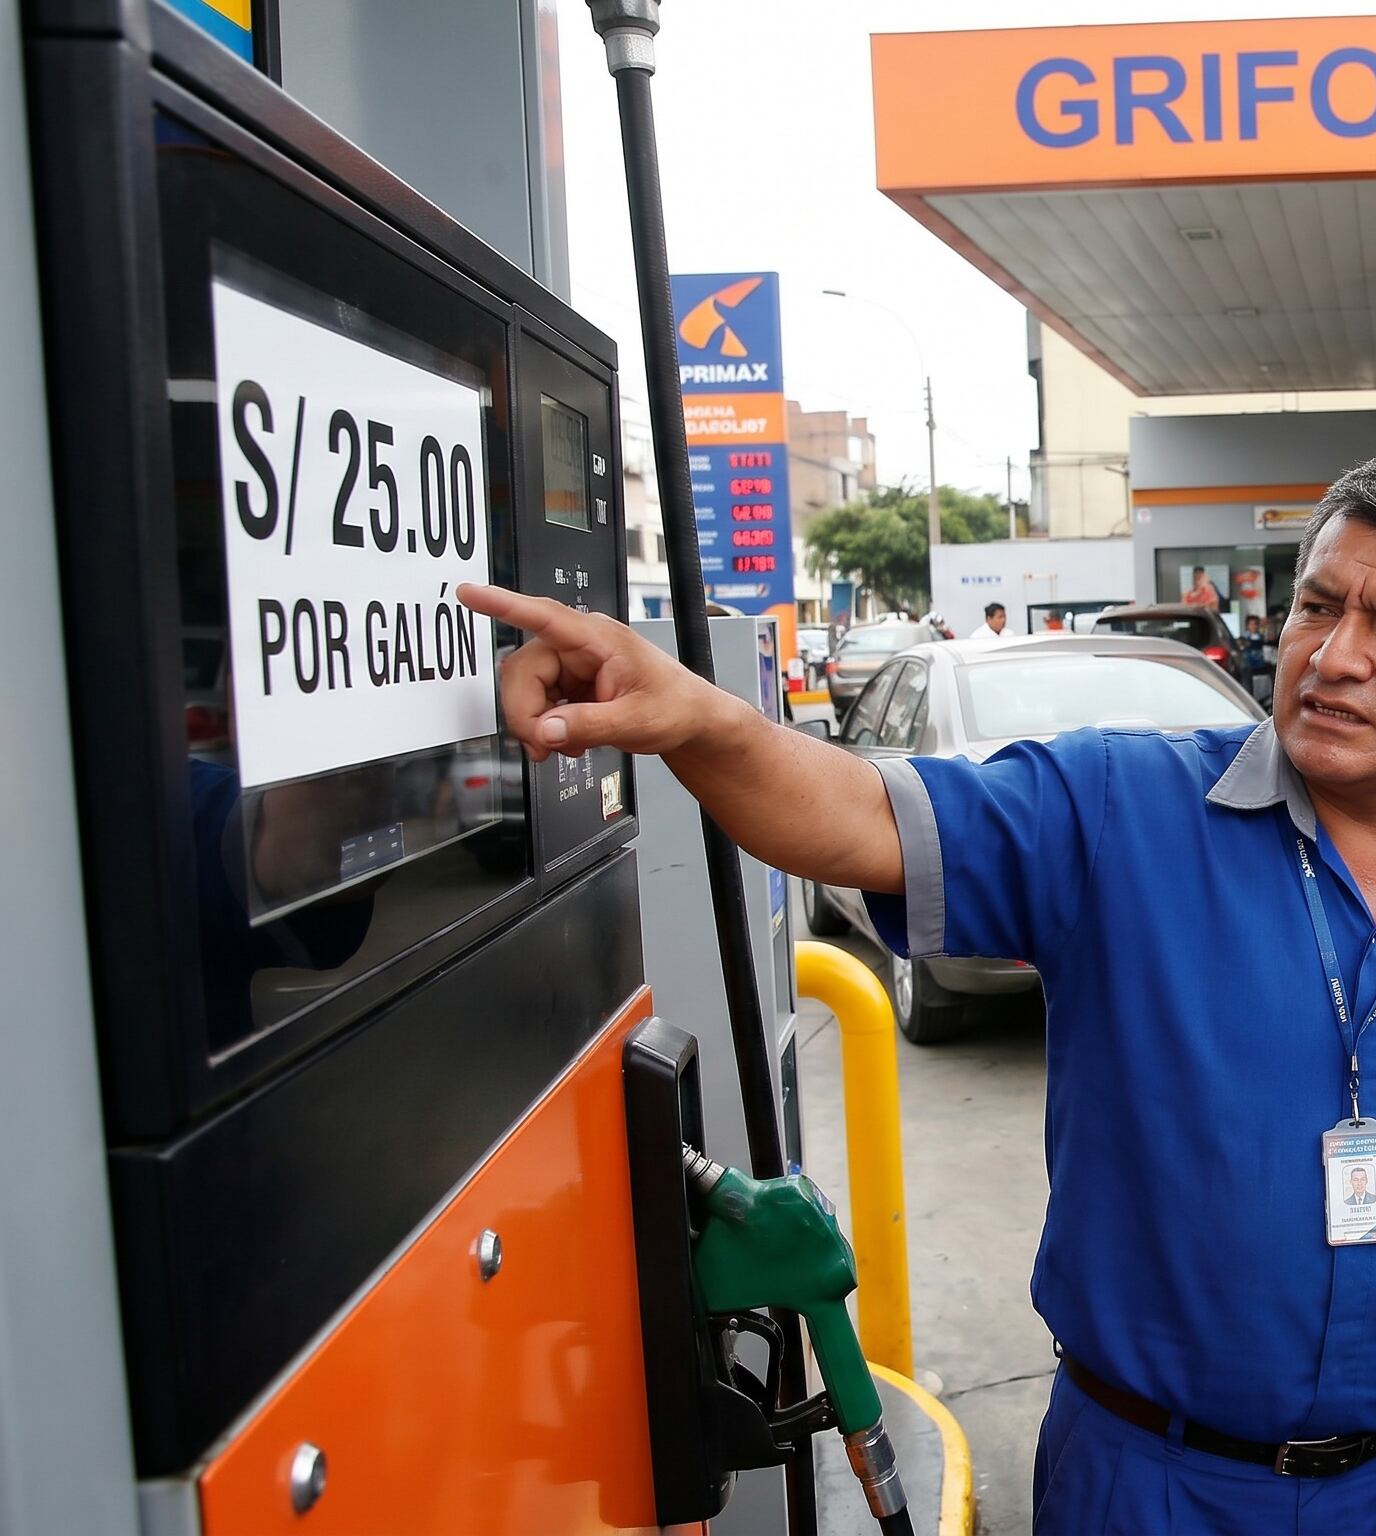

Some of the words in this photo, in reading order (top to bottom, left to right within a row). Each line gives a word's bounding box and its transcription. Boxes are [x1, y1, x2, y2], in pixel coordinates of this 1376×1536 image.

[679, 363, 768, 385] PRIMAX
[232, 379, 307, 556] S/
[328, 408, 476, 561] 25.00
[258, 598, 353, 696] POR
[365, 582, 477, 687] GALÓN
